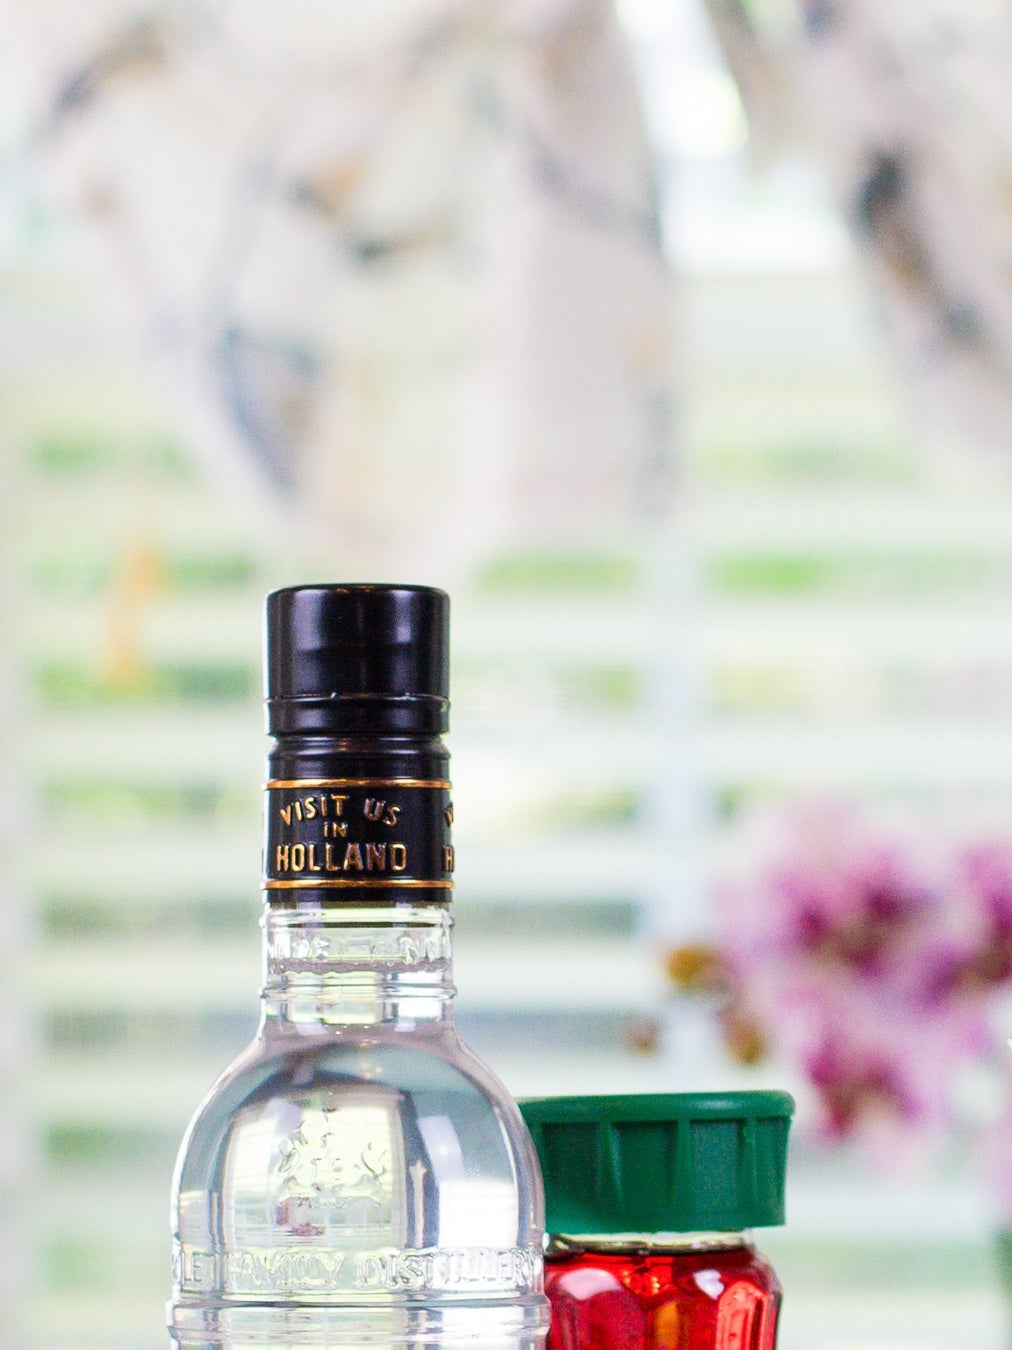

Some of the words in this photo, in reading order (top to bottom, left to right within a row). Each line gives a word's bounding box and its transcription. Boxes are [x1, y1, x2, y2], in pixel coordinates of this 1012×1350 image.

[279, 793, 349, 826] VISIT
[364, 798, 400, 826] US
[324, 822, 348, 838] IN
[276, 842, 407, 872] HOLLAND
